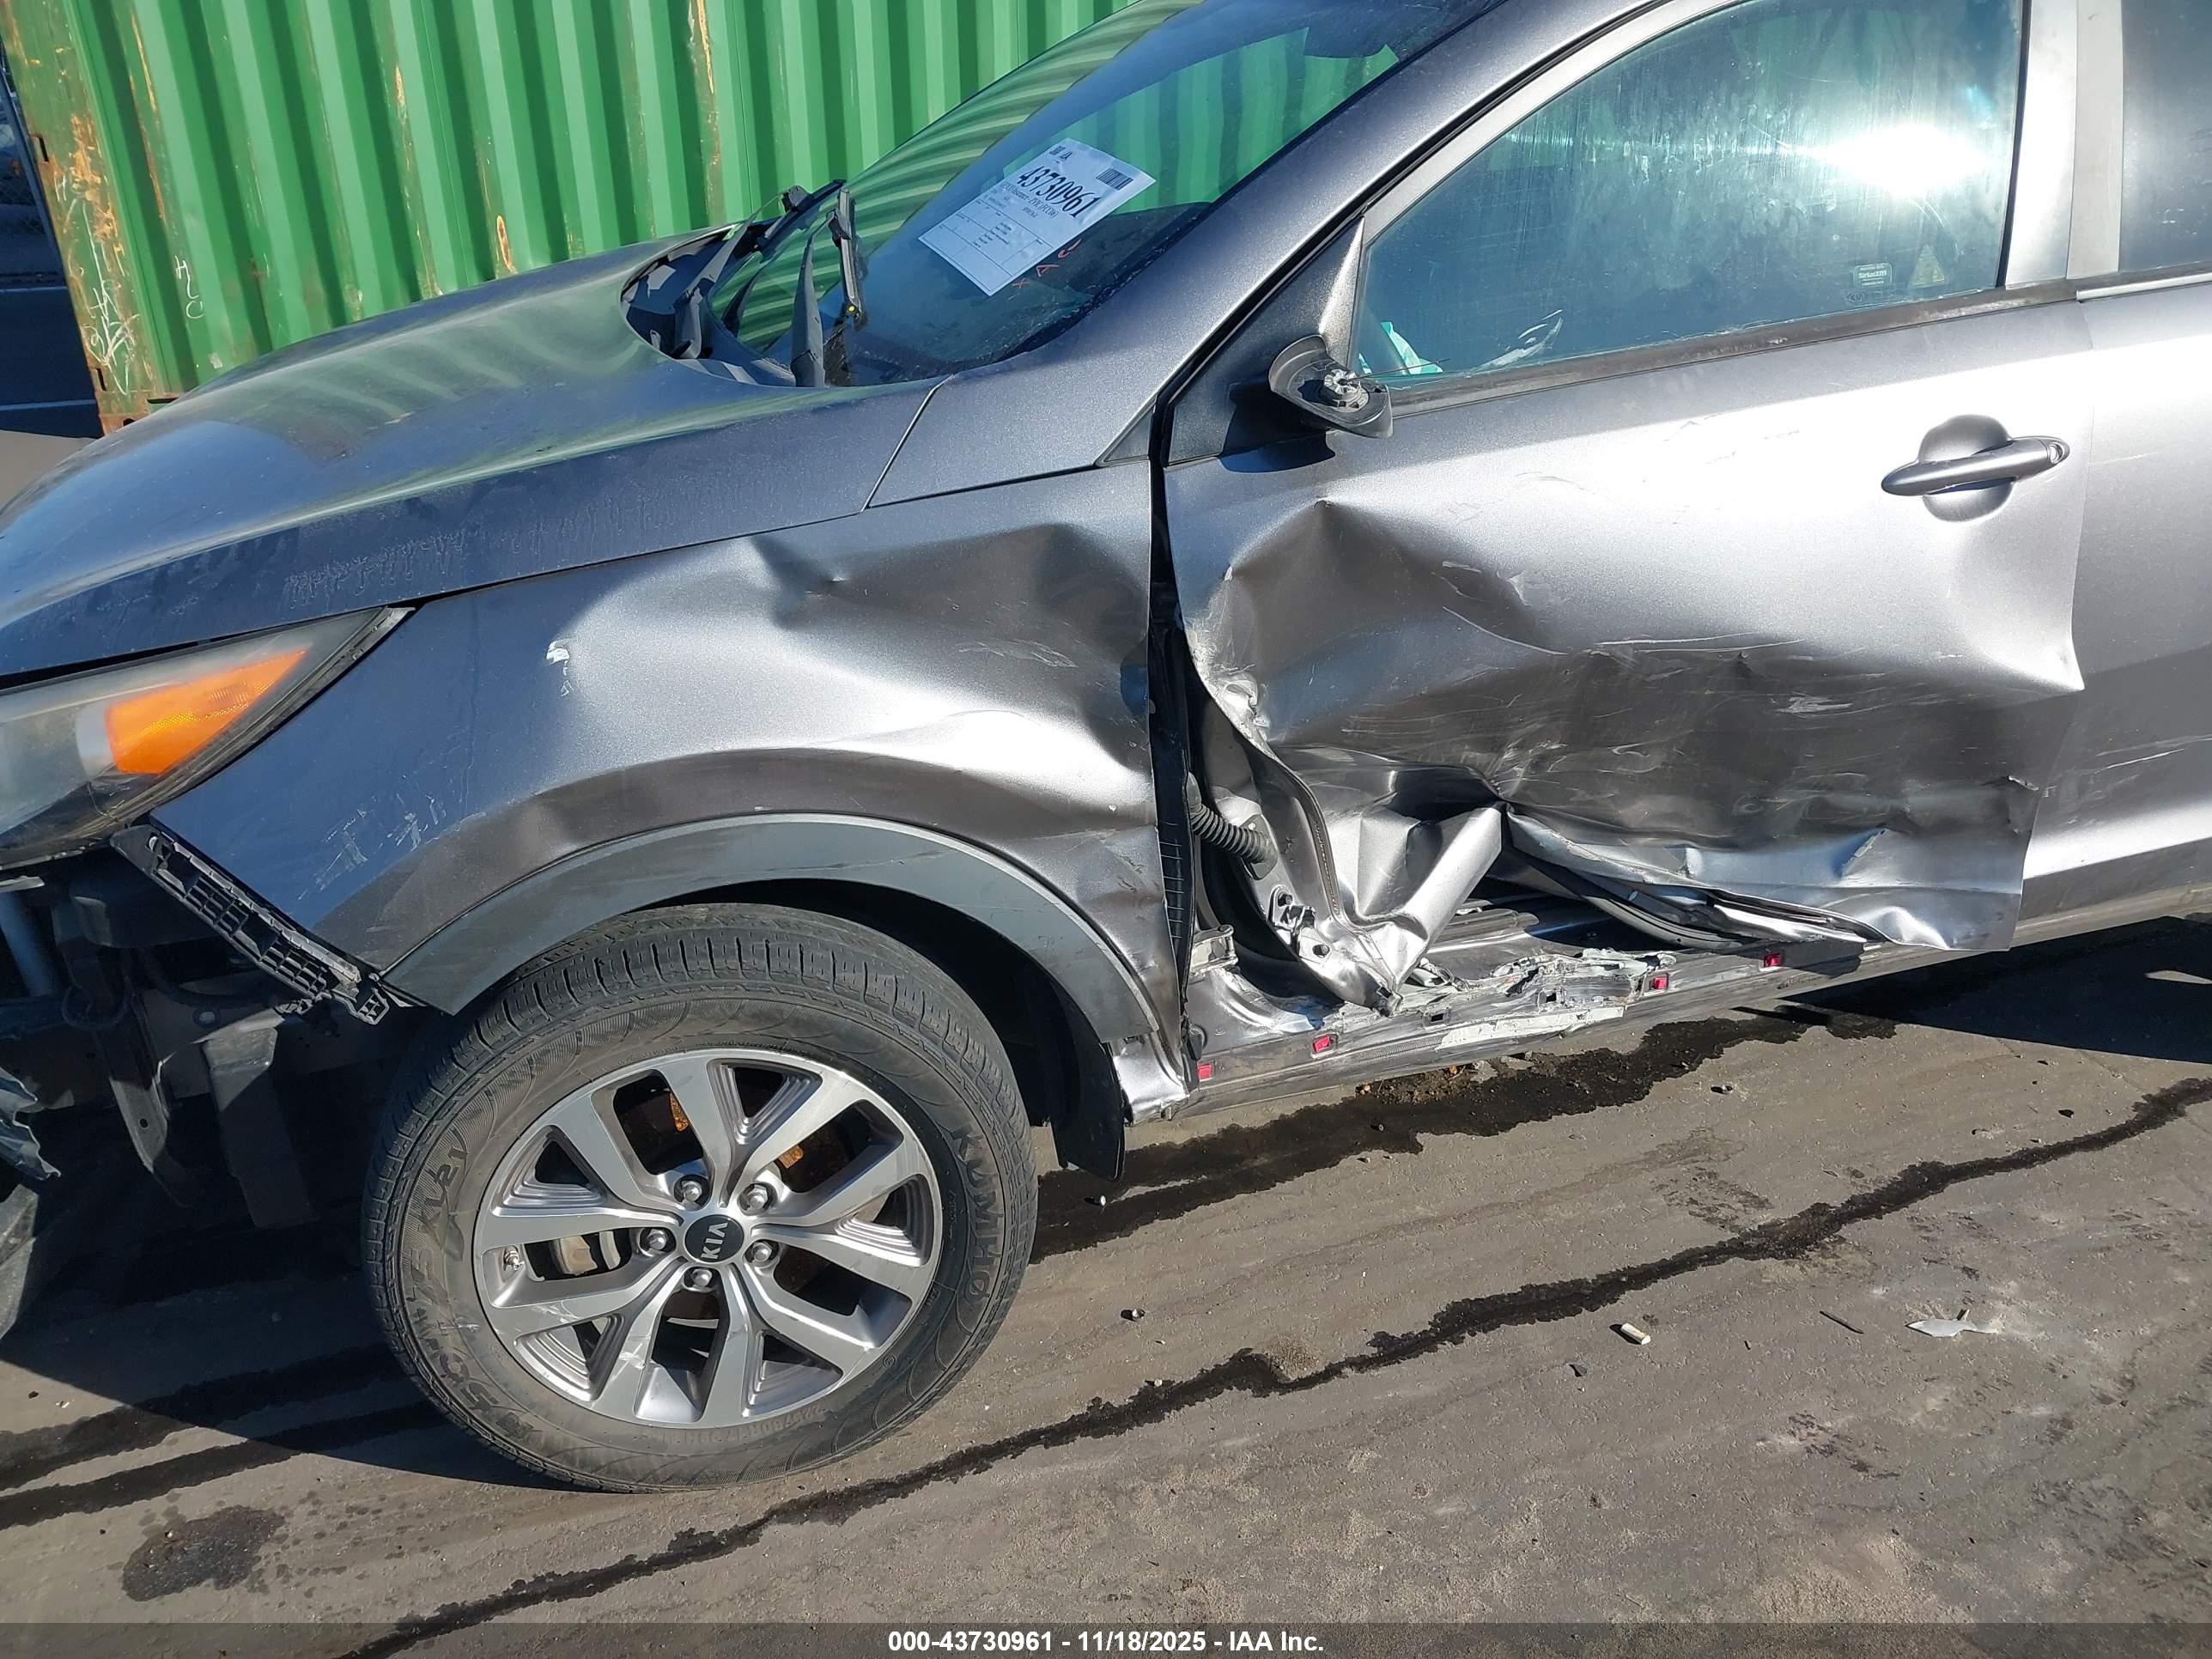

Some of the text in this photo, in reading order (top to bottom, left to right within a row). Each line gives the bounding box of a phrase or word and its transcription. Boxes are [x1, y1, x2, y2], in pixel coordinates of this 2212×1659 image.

[1017, 165, 1102, 217] 43730961
[949, 1124, 1000, 1303] KUMHO
[700, 1222, 729, 1260] KIA
